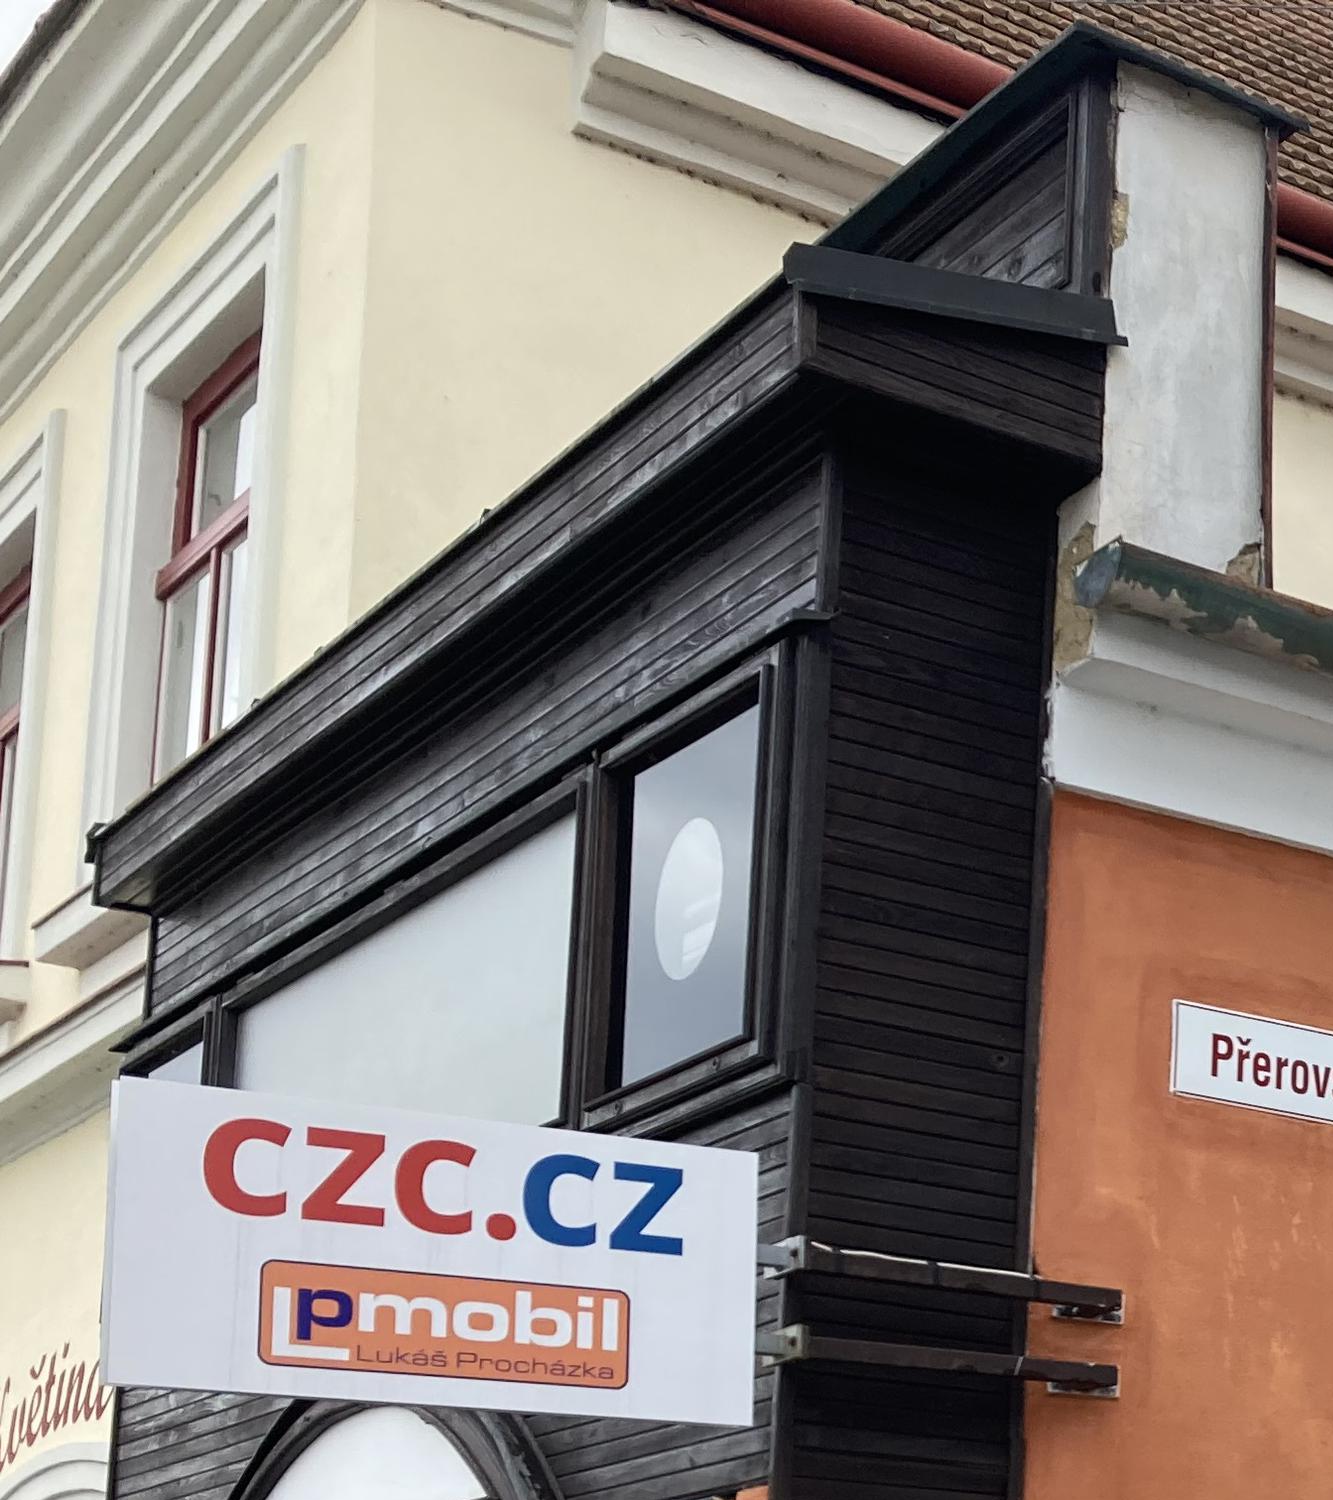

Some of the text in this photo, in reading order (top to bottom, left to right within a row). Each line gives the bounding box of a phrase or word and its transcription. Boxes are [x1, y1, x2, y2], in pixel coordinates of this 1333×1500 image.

[203, 1118, 684, 1256] CZC.CZ
[356, 1345, 615, 1381] Lukáš Procházka
